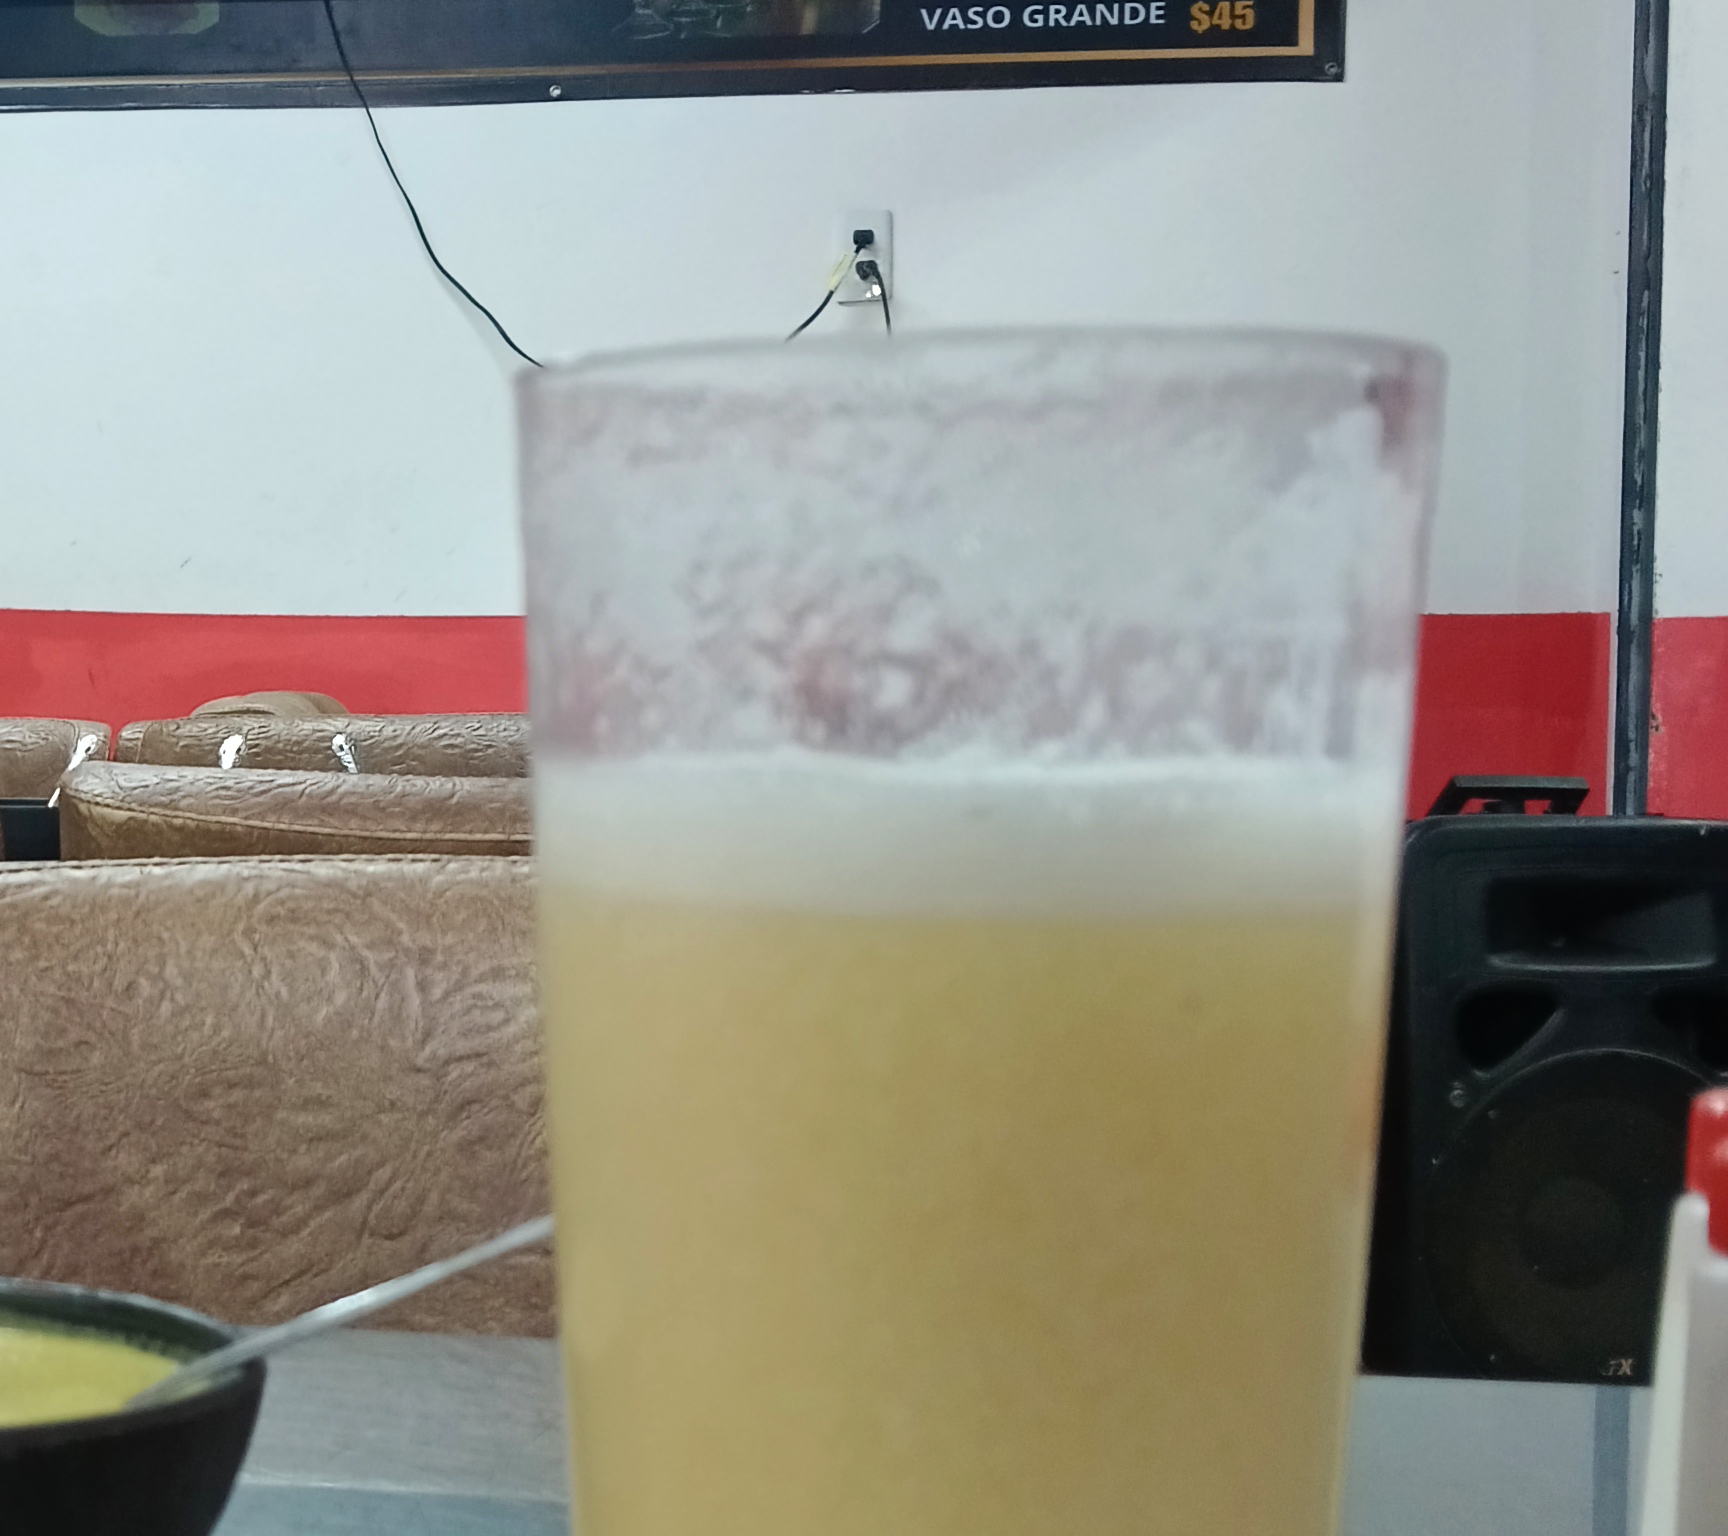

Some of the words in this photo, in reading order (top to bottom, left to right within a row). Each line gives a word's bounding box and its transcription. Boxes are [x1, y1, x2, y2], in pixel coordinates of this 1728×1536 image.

[920, 5, 1012, 32] VASO
[1020, 0, 1167, 30] GRANDE
[1189, 0, 1257, 33] $45
